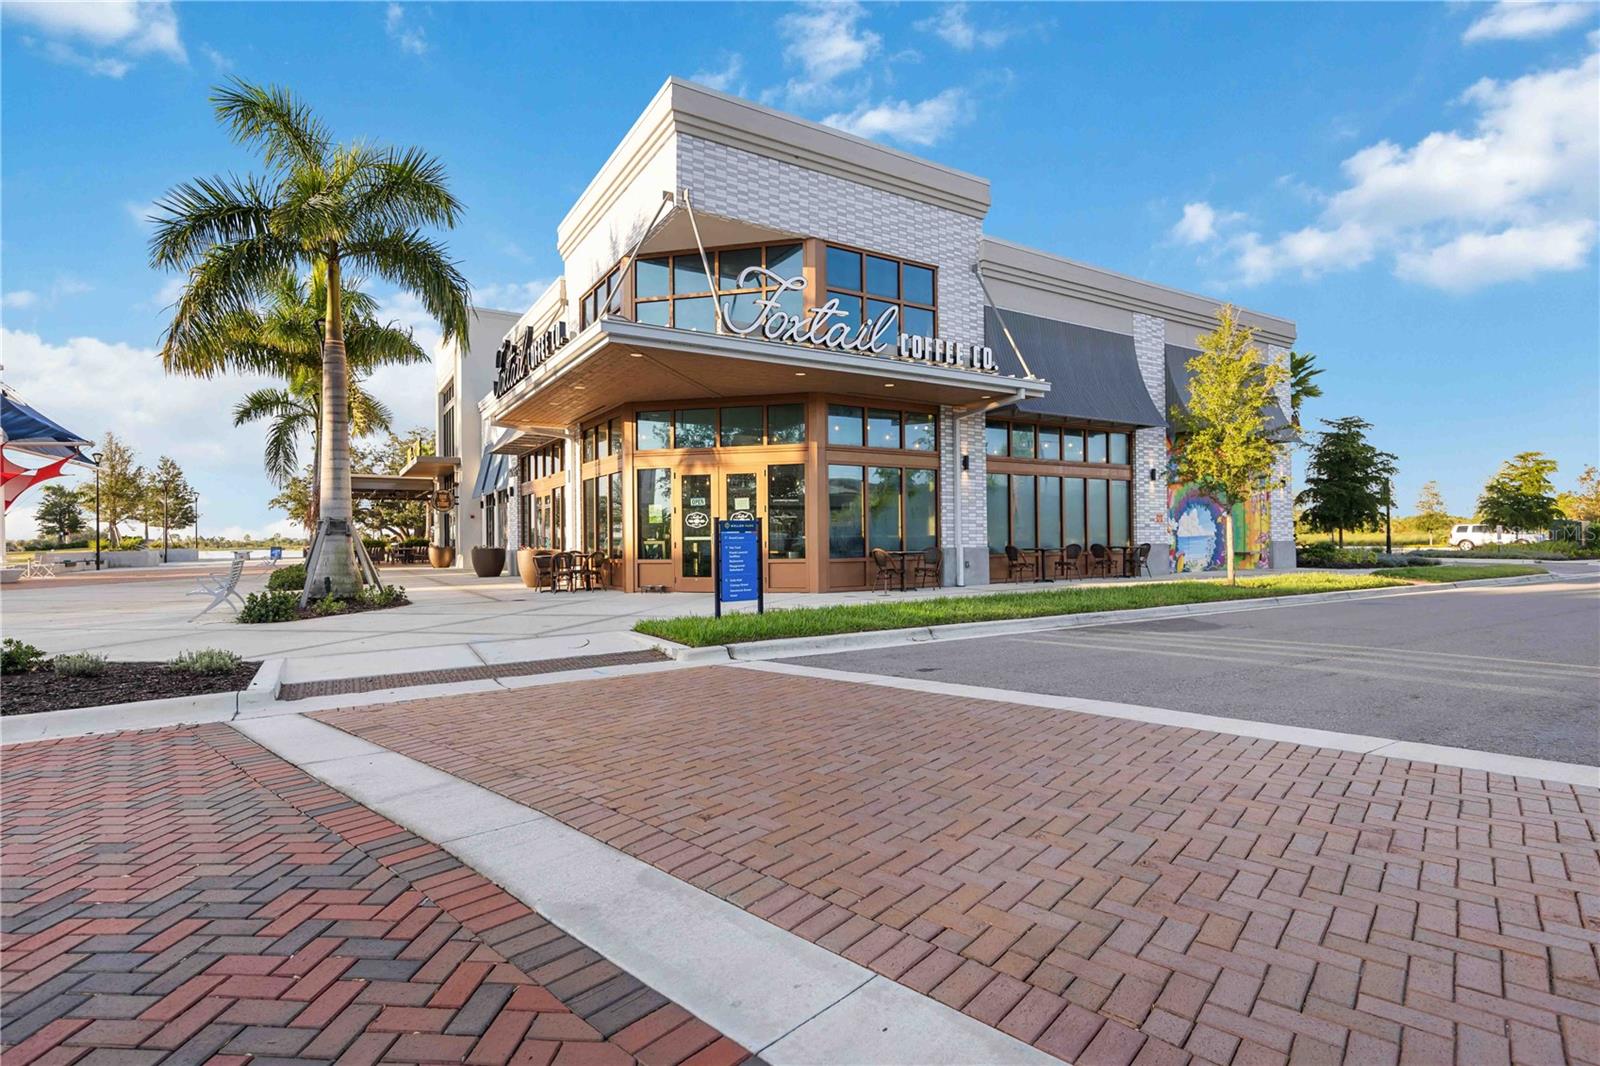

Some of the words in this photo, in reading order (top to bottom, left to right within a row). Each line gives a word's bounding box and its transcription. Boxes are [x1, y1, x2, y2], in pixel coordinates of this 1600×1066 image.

[722, 266, 899, 353] Foxtail
[901, 333, 964, 366] COFFEE
[972, 346, 999, 370] CO.
